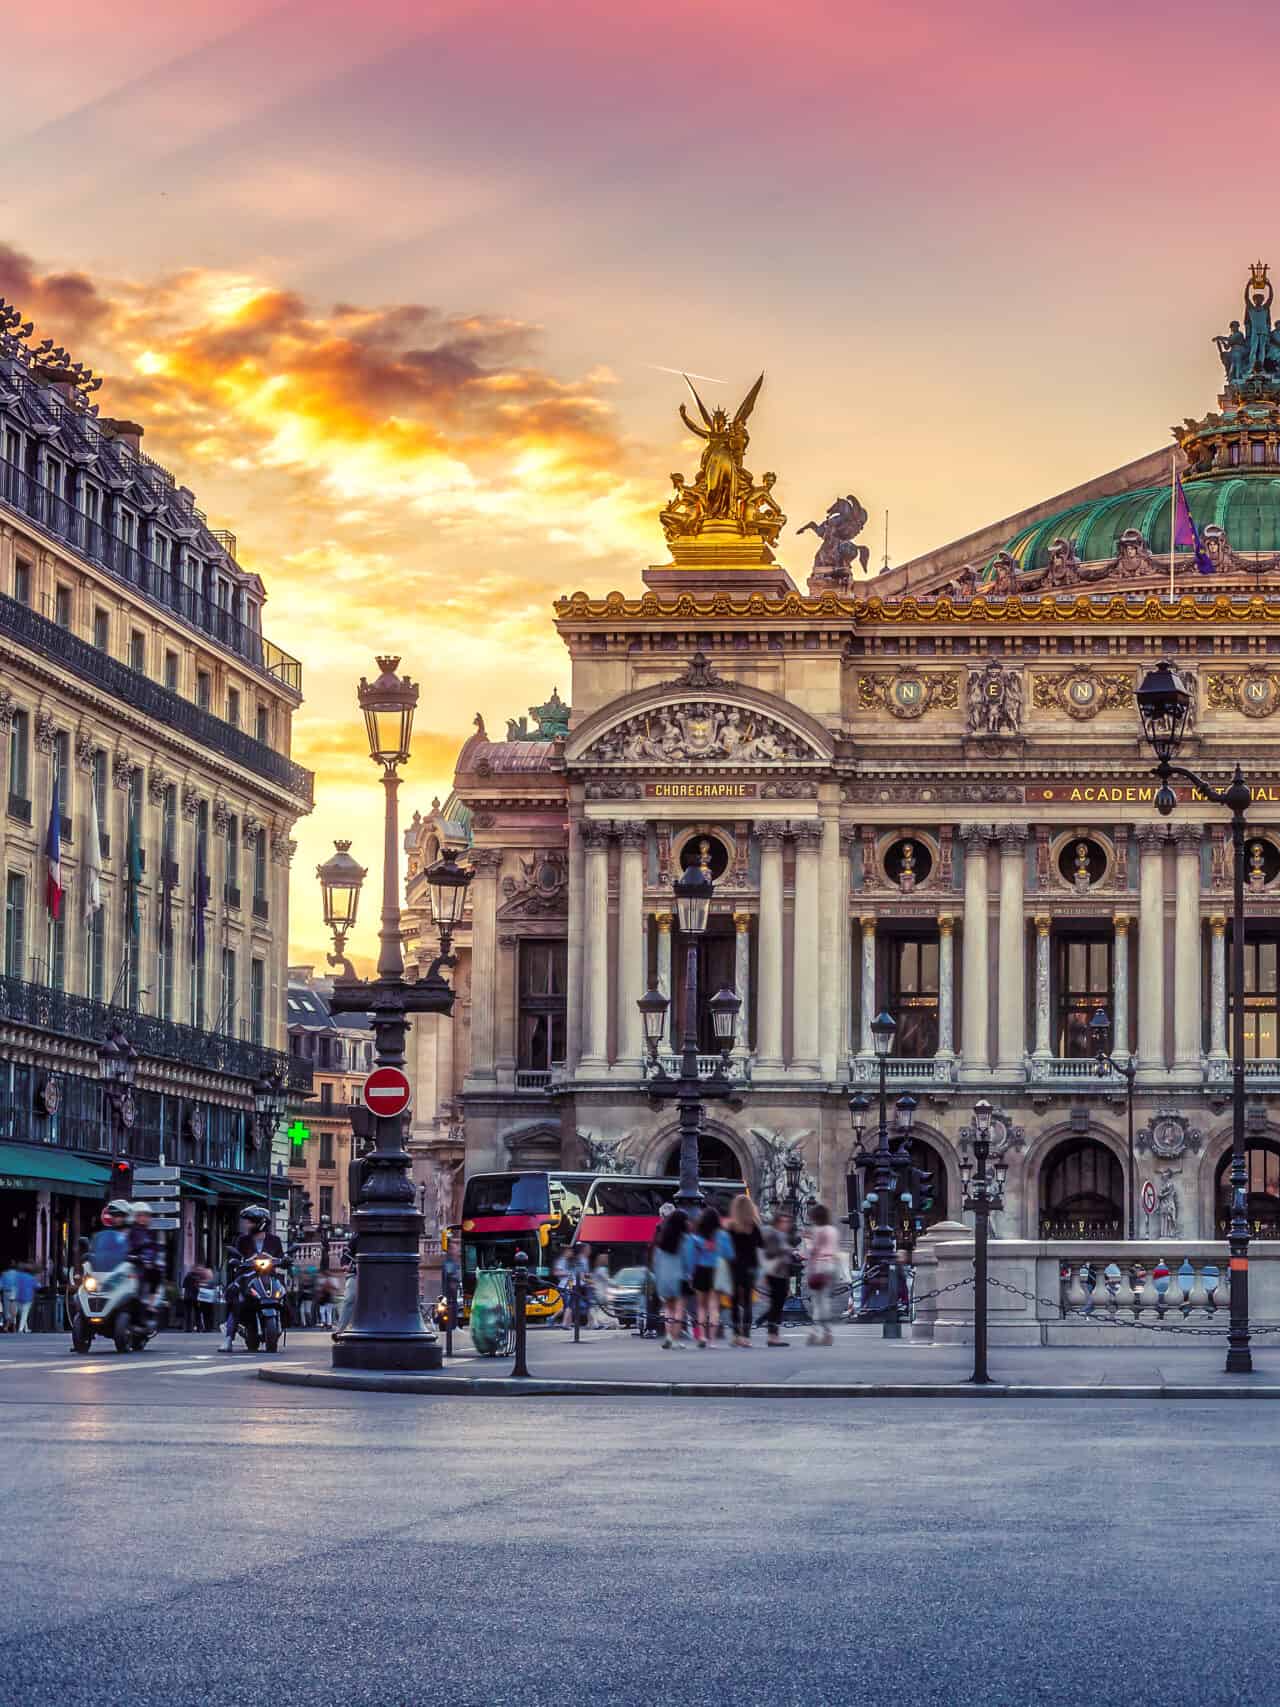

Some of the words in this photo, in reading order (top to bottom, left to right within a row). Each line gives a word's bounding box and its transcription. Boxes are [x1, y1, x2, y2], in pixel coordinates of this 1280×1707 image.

[903, 686, 914, 698] N
[989, 685, 998, 695] E
[1077, 686, 1088, 697] N
[1252, 686, 1263, 697] N
[655, 784, 746, 797] CHOREGRAPHIE
